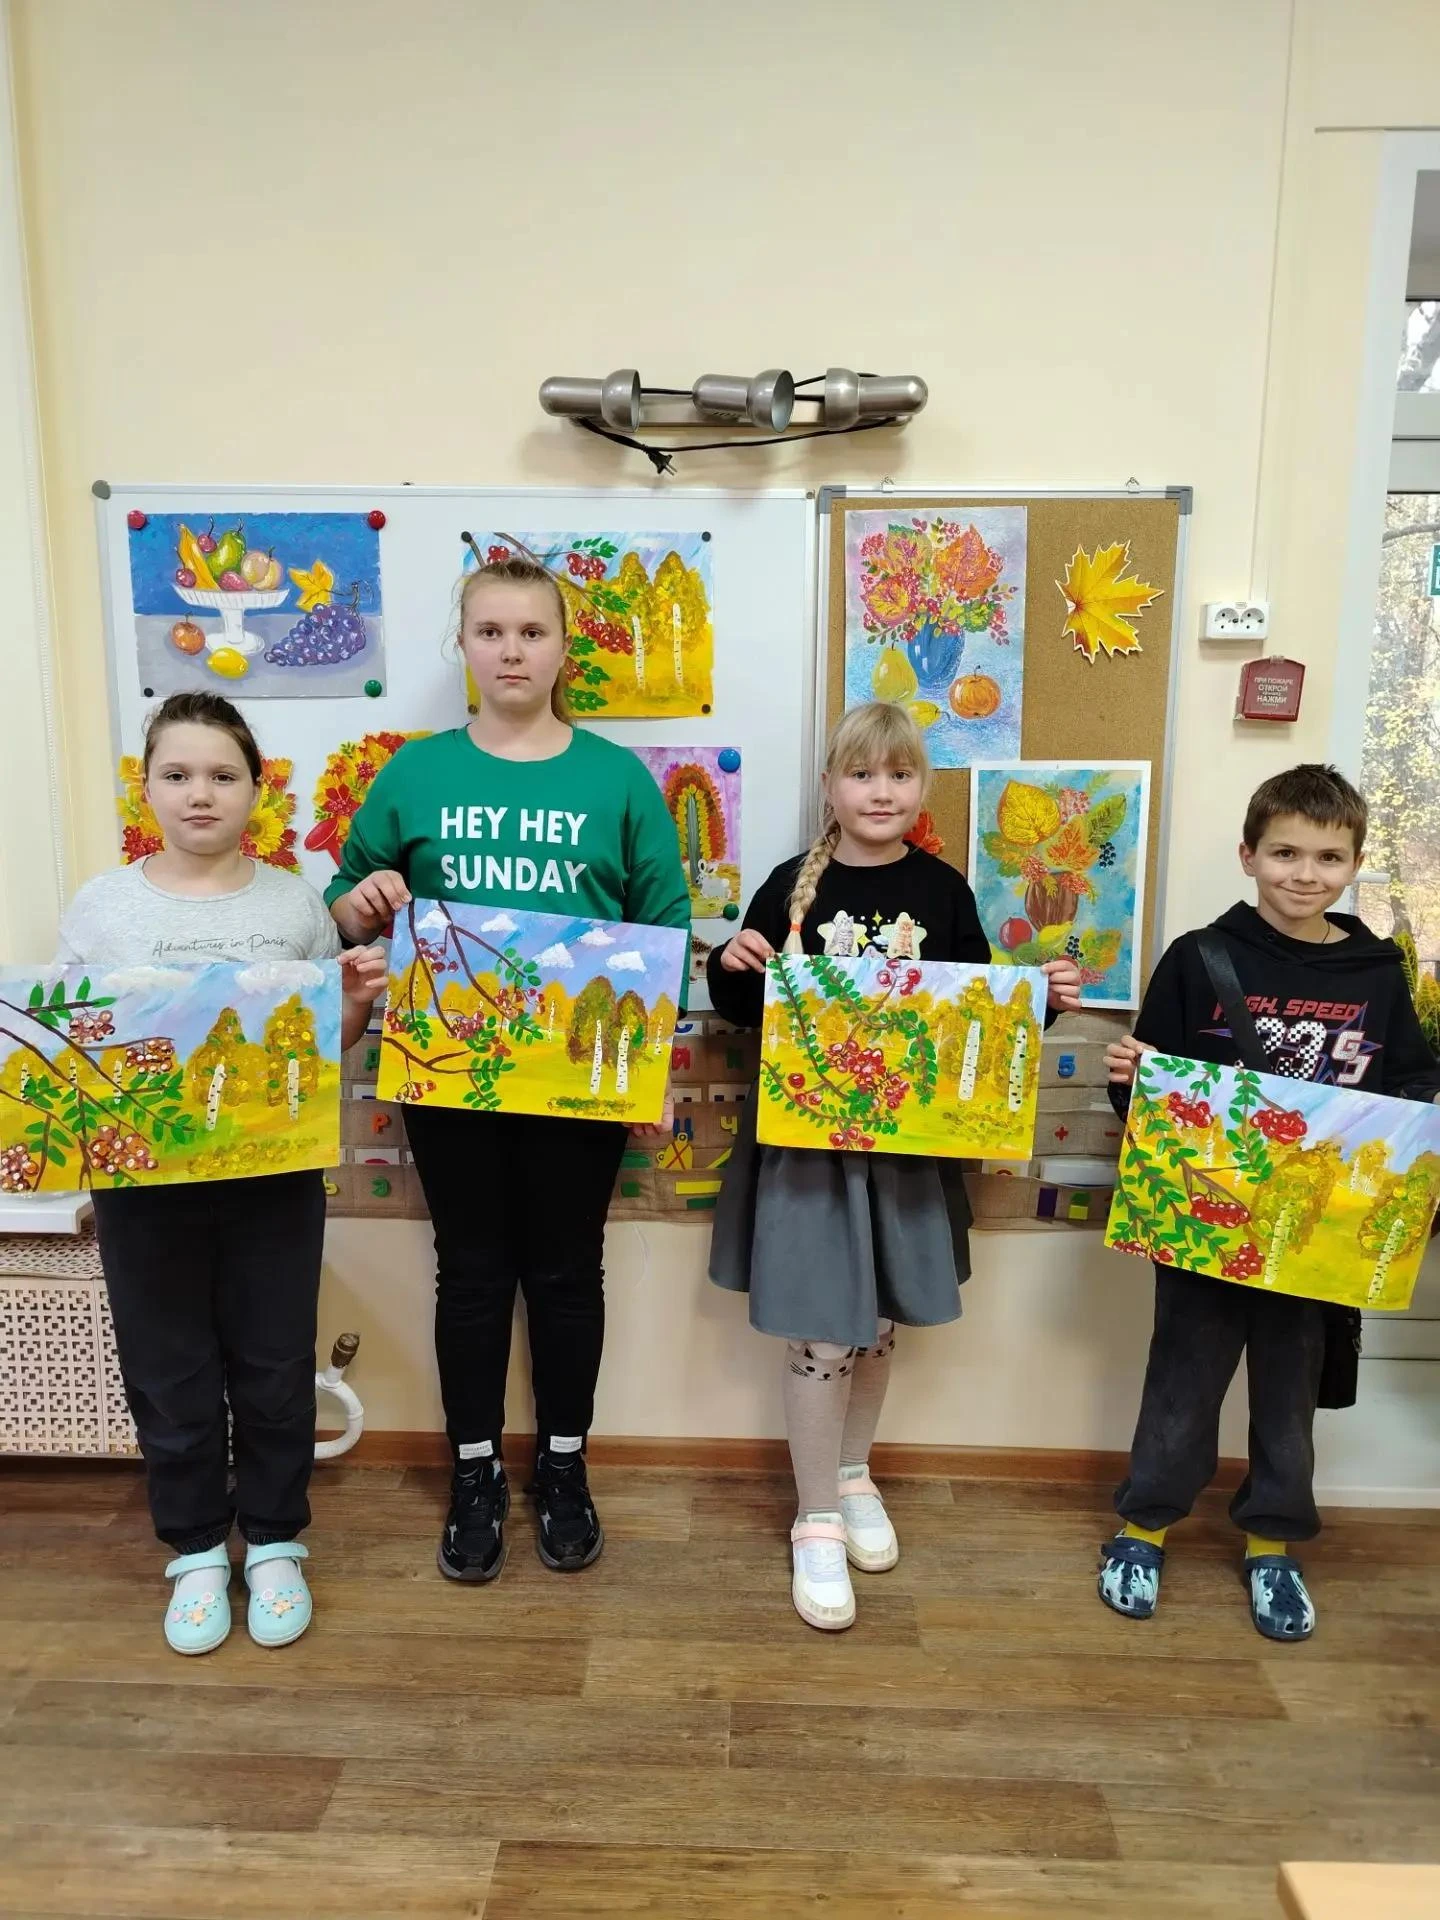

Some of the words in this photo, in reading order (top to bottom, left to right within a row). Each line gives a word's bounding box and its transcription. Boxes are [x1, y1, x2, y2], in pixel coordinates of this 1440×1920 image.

[1257, 695, 1288, 704] НАЖМИ
[441, 806, 508, 839] HEY
[520, 808, 588, 846] HEY
[441, 854, 587, 893] SUNDAY
[152, 938, 226, 957] Adventures
[230, 938, 244, 948] in
[247, 933, 287, 952] Paris
[1283, 998, 1362, 1021] SPEED
[1058, 1054, 1076, 1077] 5
